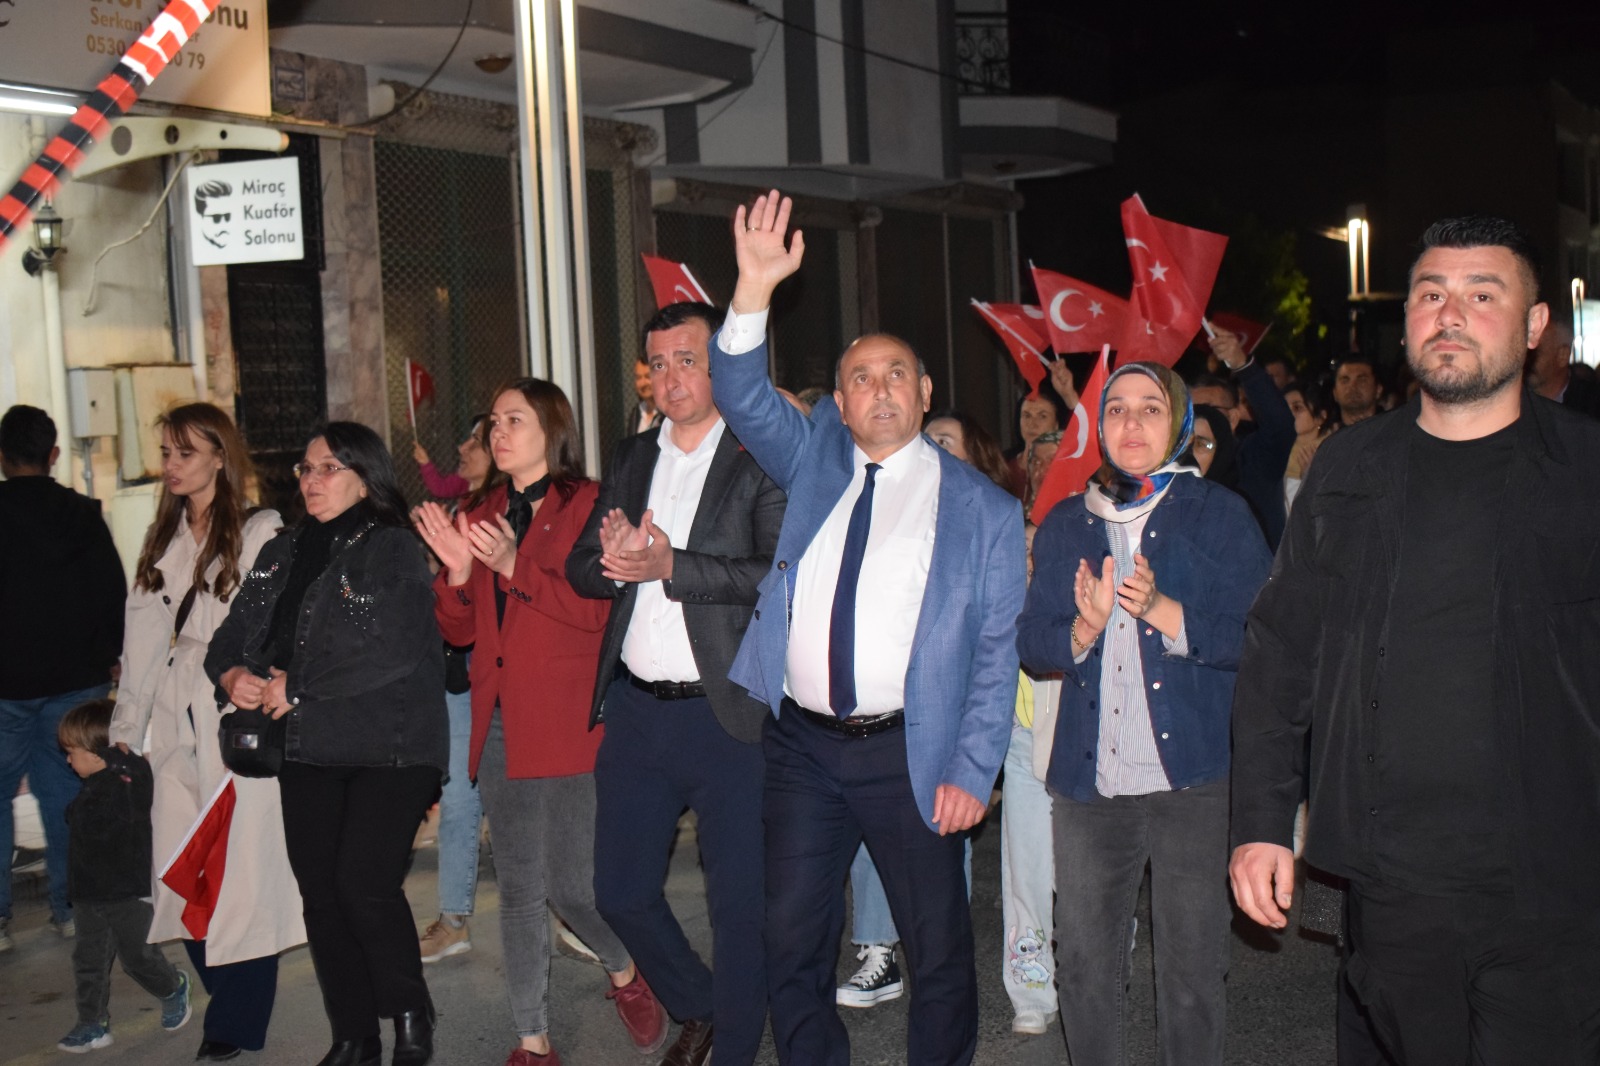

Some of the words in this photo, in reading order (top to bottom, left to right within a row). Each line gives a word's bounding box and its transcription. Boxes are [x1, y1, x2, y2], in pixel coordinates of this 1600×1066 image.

[90, 6, 143, 32] Serkan
[87, 34, 126, 57] 0530
[167, 50, 182, 67] 0
[187, 51, 205, 70] 79
[242, 179, 285, 198] Miraç
[243, 203, 296, 221] Kuaför
[244, 229, 296, 246] Salonu
